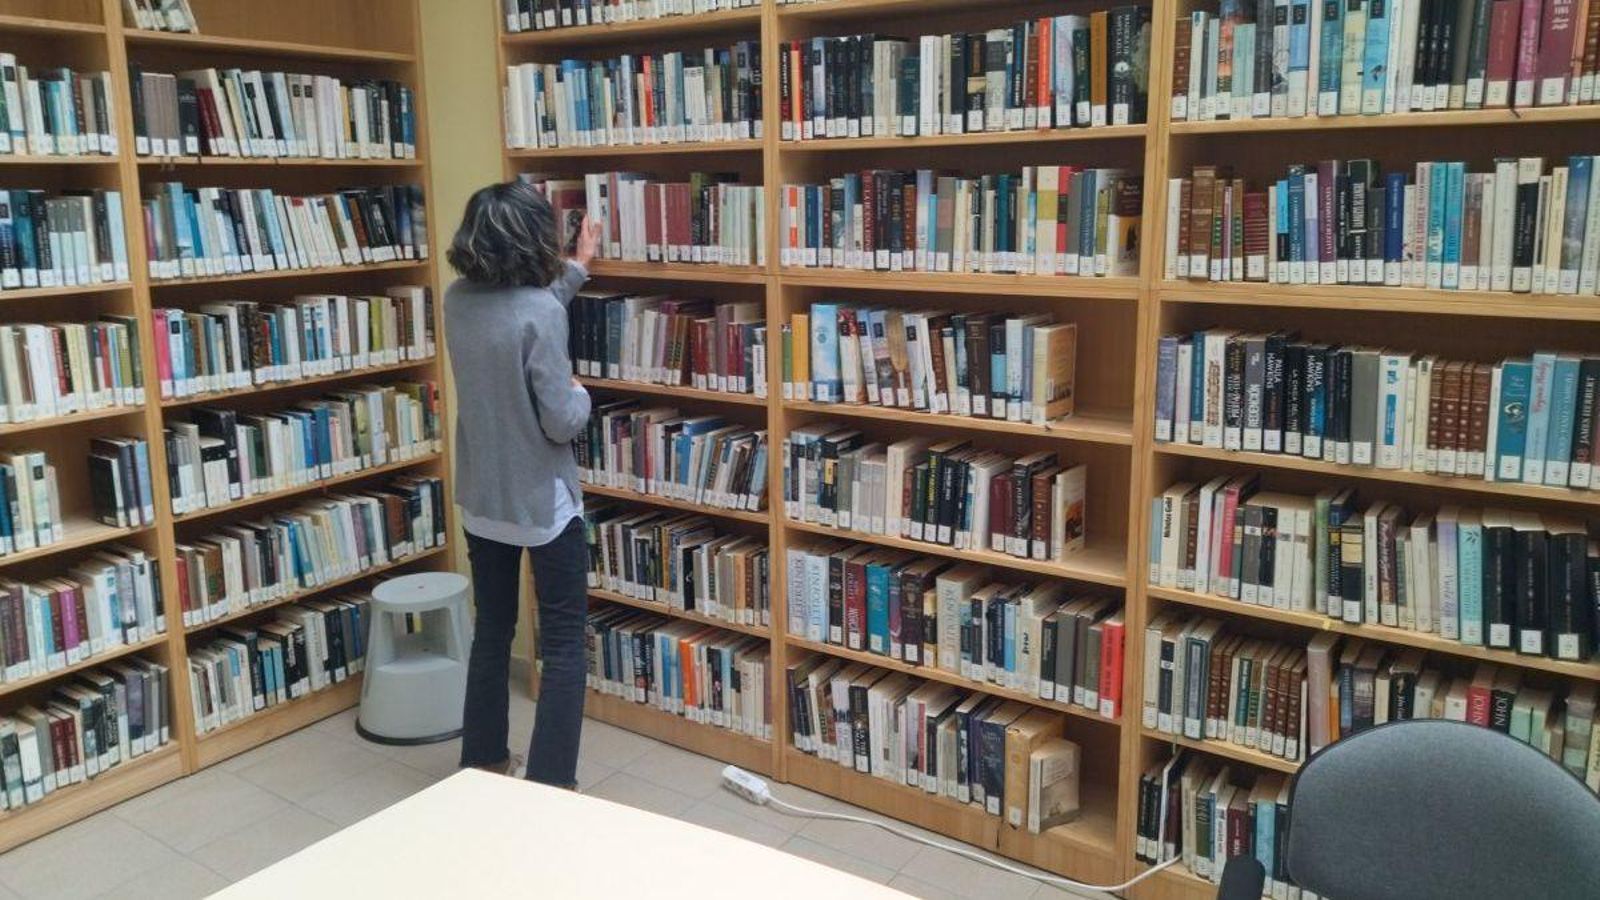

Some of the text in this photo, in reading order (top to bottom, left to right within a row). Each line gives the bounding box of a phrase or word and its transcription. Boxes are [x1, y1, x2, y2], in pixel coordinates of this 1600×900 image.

[1266, 352, 1275, 389] HAWKINS
[1274, 359, 1283, 384] PAULA
[1306, 355, 1315, 392] HAWKINS
[1315, 361, 1323, 386] PAULA
[1582, 377, 1596, 417] HERBERT
[1579, 418, 1592, 445] JAMES
[793, 579, 804, 619] FOLLETT
[811, 585, 821, 626] FOLLETT
[1472, 695, 1485, 725] JOHN
[1495, 696, 1508, 726] JOHN
